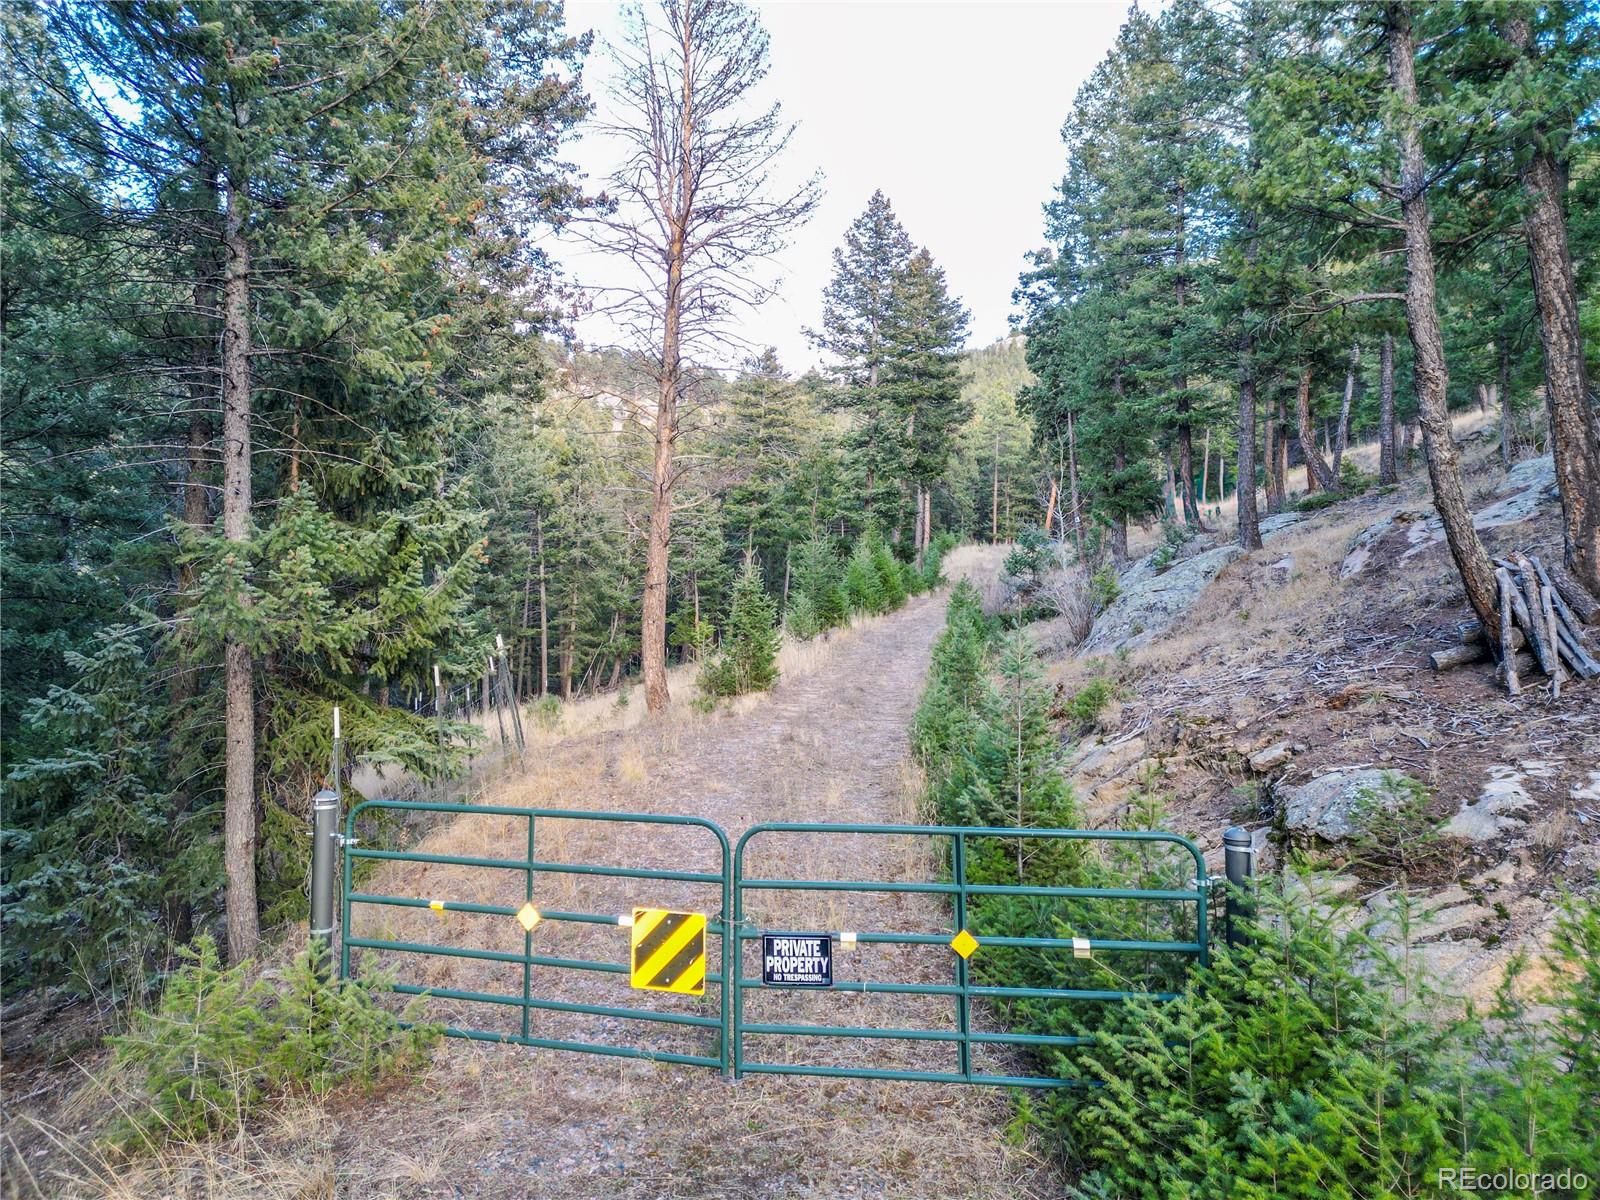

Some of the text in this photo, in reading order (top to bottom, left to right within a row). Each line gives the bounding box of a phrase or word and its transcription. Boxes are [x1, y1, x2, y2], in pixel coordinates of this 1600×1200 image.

[773, 939, 821, 957] PRIVATE
[766, 956, 828, 973] PROPERTY
[773, 973, 822, 982] NO TRESPASSING
